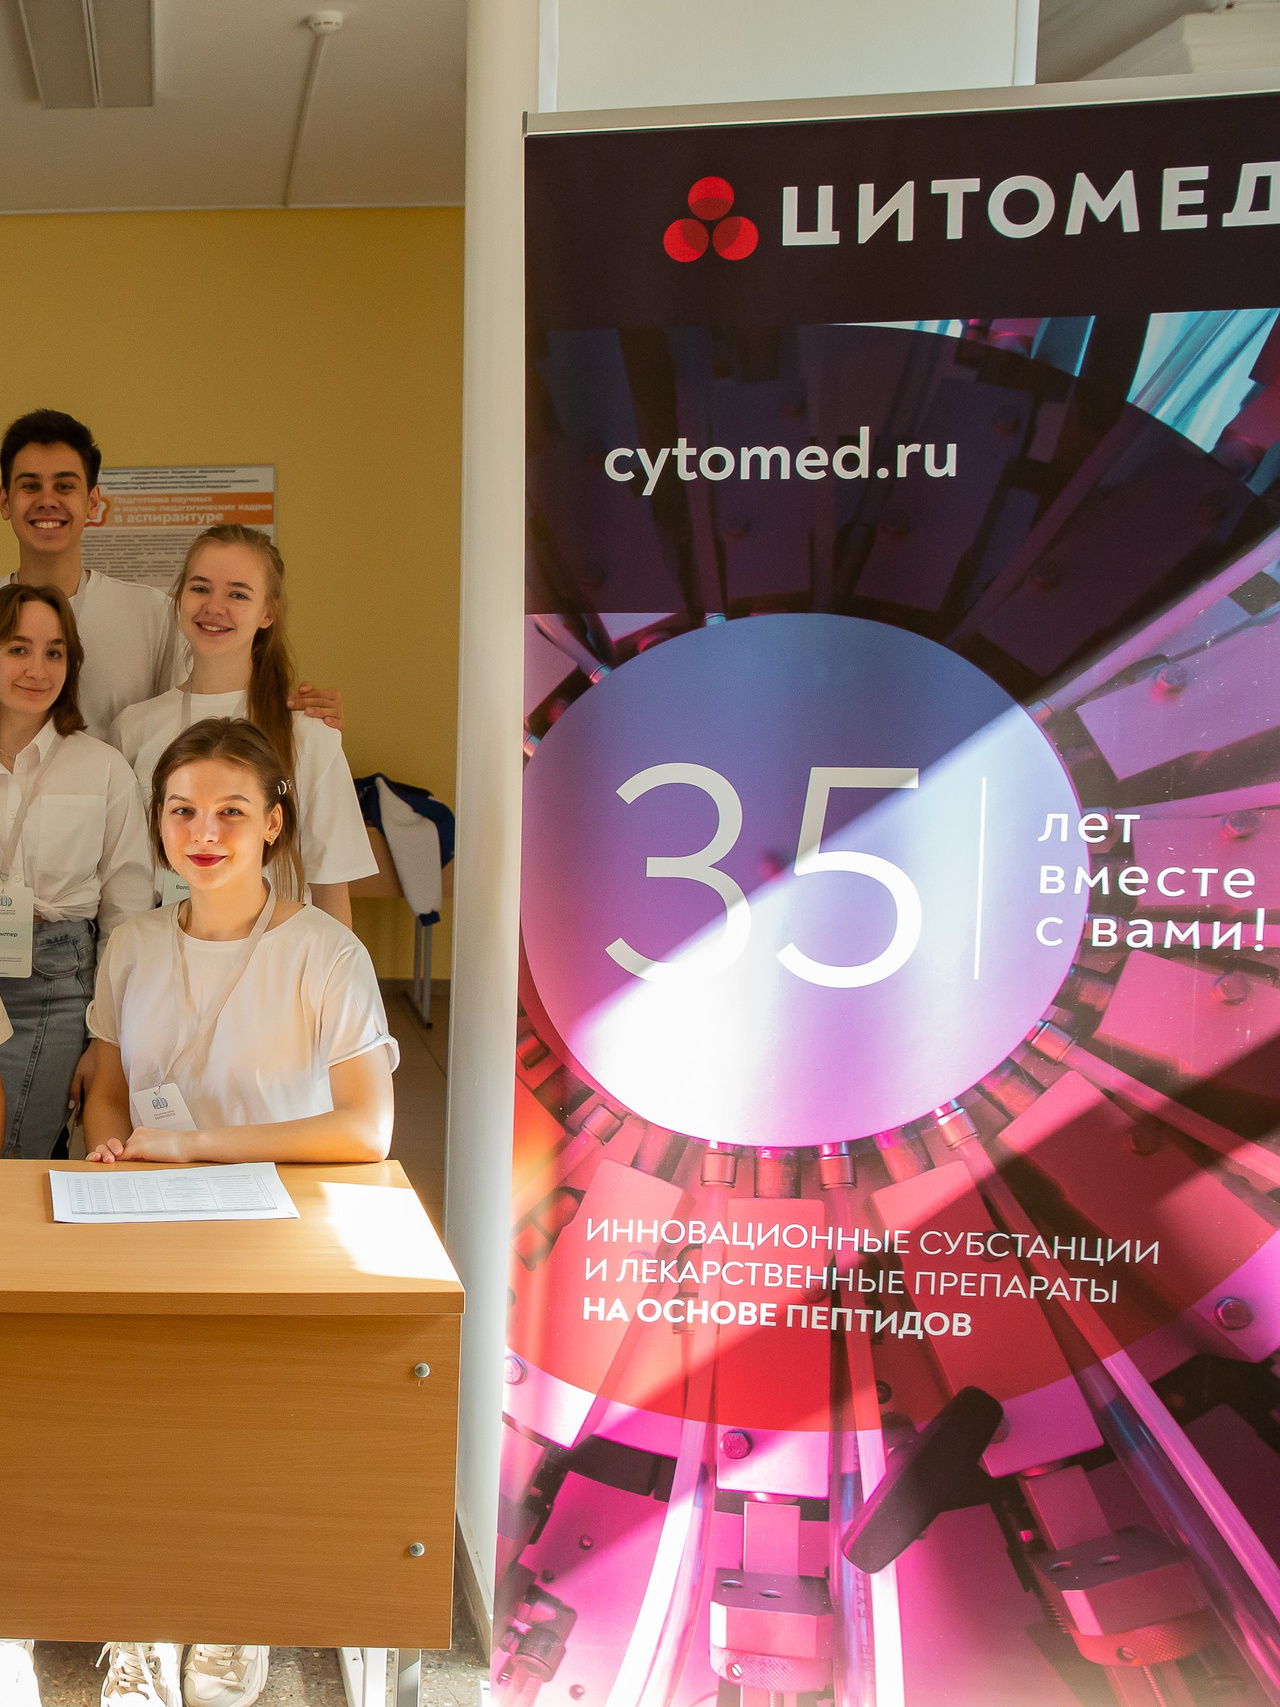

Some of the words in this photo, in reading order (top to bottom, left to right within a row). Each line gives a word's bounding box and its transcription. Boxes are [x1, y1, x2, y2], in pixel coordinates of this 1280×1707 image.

[781, 161, 1280, 247] ЦИТОМЕД
[604, 426, 958, 496] cytomed.ru
[114, 514, 122, 523] в
[126, 511, 224, 525] аспирантуре
[1037, 812, 1141, 844] лет
[604, 761, 923, 989] 35
[1039, 864, 1256, 899] вместе
[1035, 916, 1064, 946] с
[1091, 907, 1266, 952] вами!
[586, 1217, 910, 1255] ИННОВАЦИОННЫЕ
[919, 1231, 1161, 1266] СУБСТАНЦИИ
[585, 1258, 608, 1282] И
[616, 1258, 906, 1296] ЛЕКАРСТВЕННЫЕ
[915, 1272, 1118, 1304] ПРЕПАРАТЫ
[582, 1297, 629, 1322] НА
[635, 1299, 777, 1328] ОСНОВЕ
[786, 1304, 972, 1340] ПЕПТИДОВ
